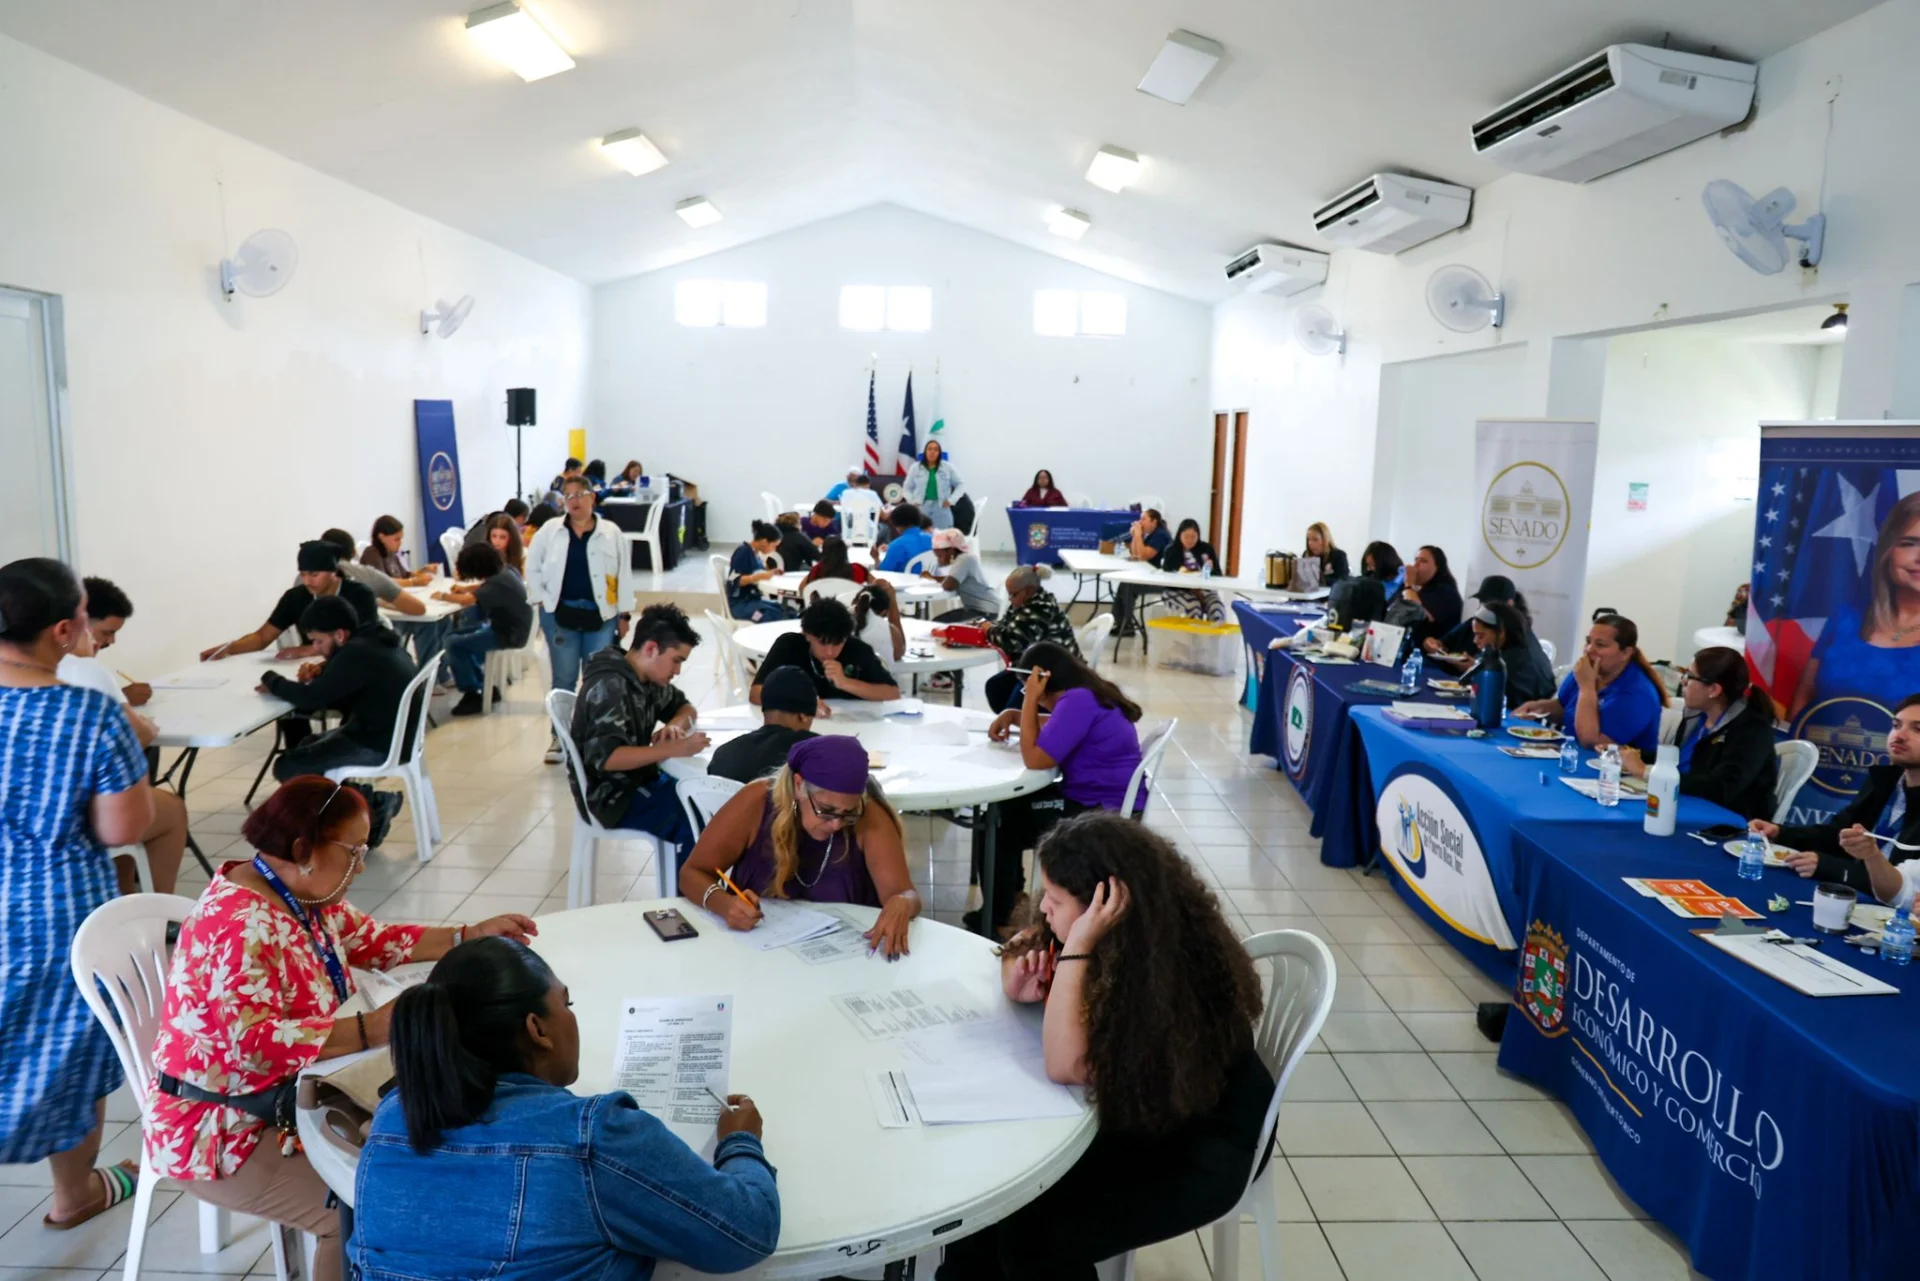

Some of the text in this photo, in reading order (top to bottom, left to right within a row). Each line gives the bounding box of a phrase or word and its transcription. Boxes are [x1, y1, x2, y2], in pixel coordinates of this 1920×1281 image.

[1489, 517, 1559, 540] SENADO
[1818, 746, 1891, 768] ENADO
[1440, 818, 1464, 860] Social
[1576, 926, 1636, 984] DEPARTAMENTO DE
[1574, 952, 1785, 1171] DESARROLLO
[1571, 1002, 1762, 1200] ECONÓMICO Y COMERCIO
